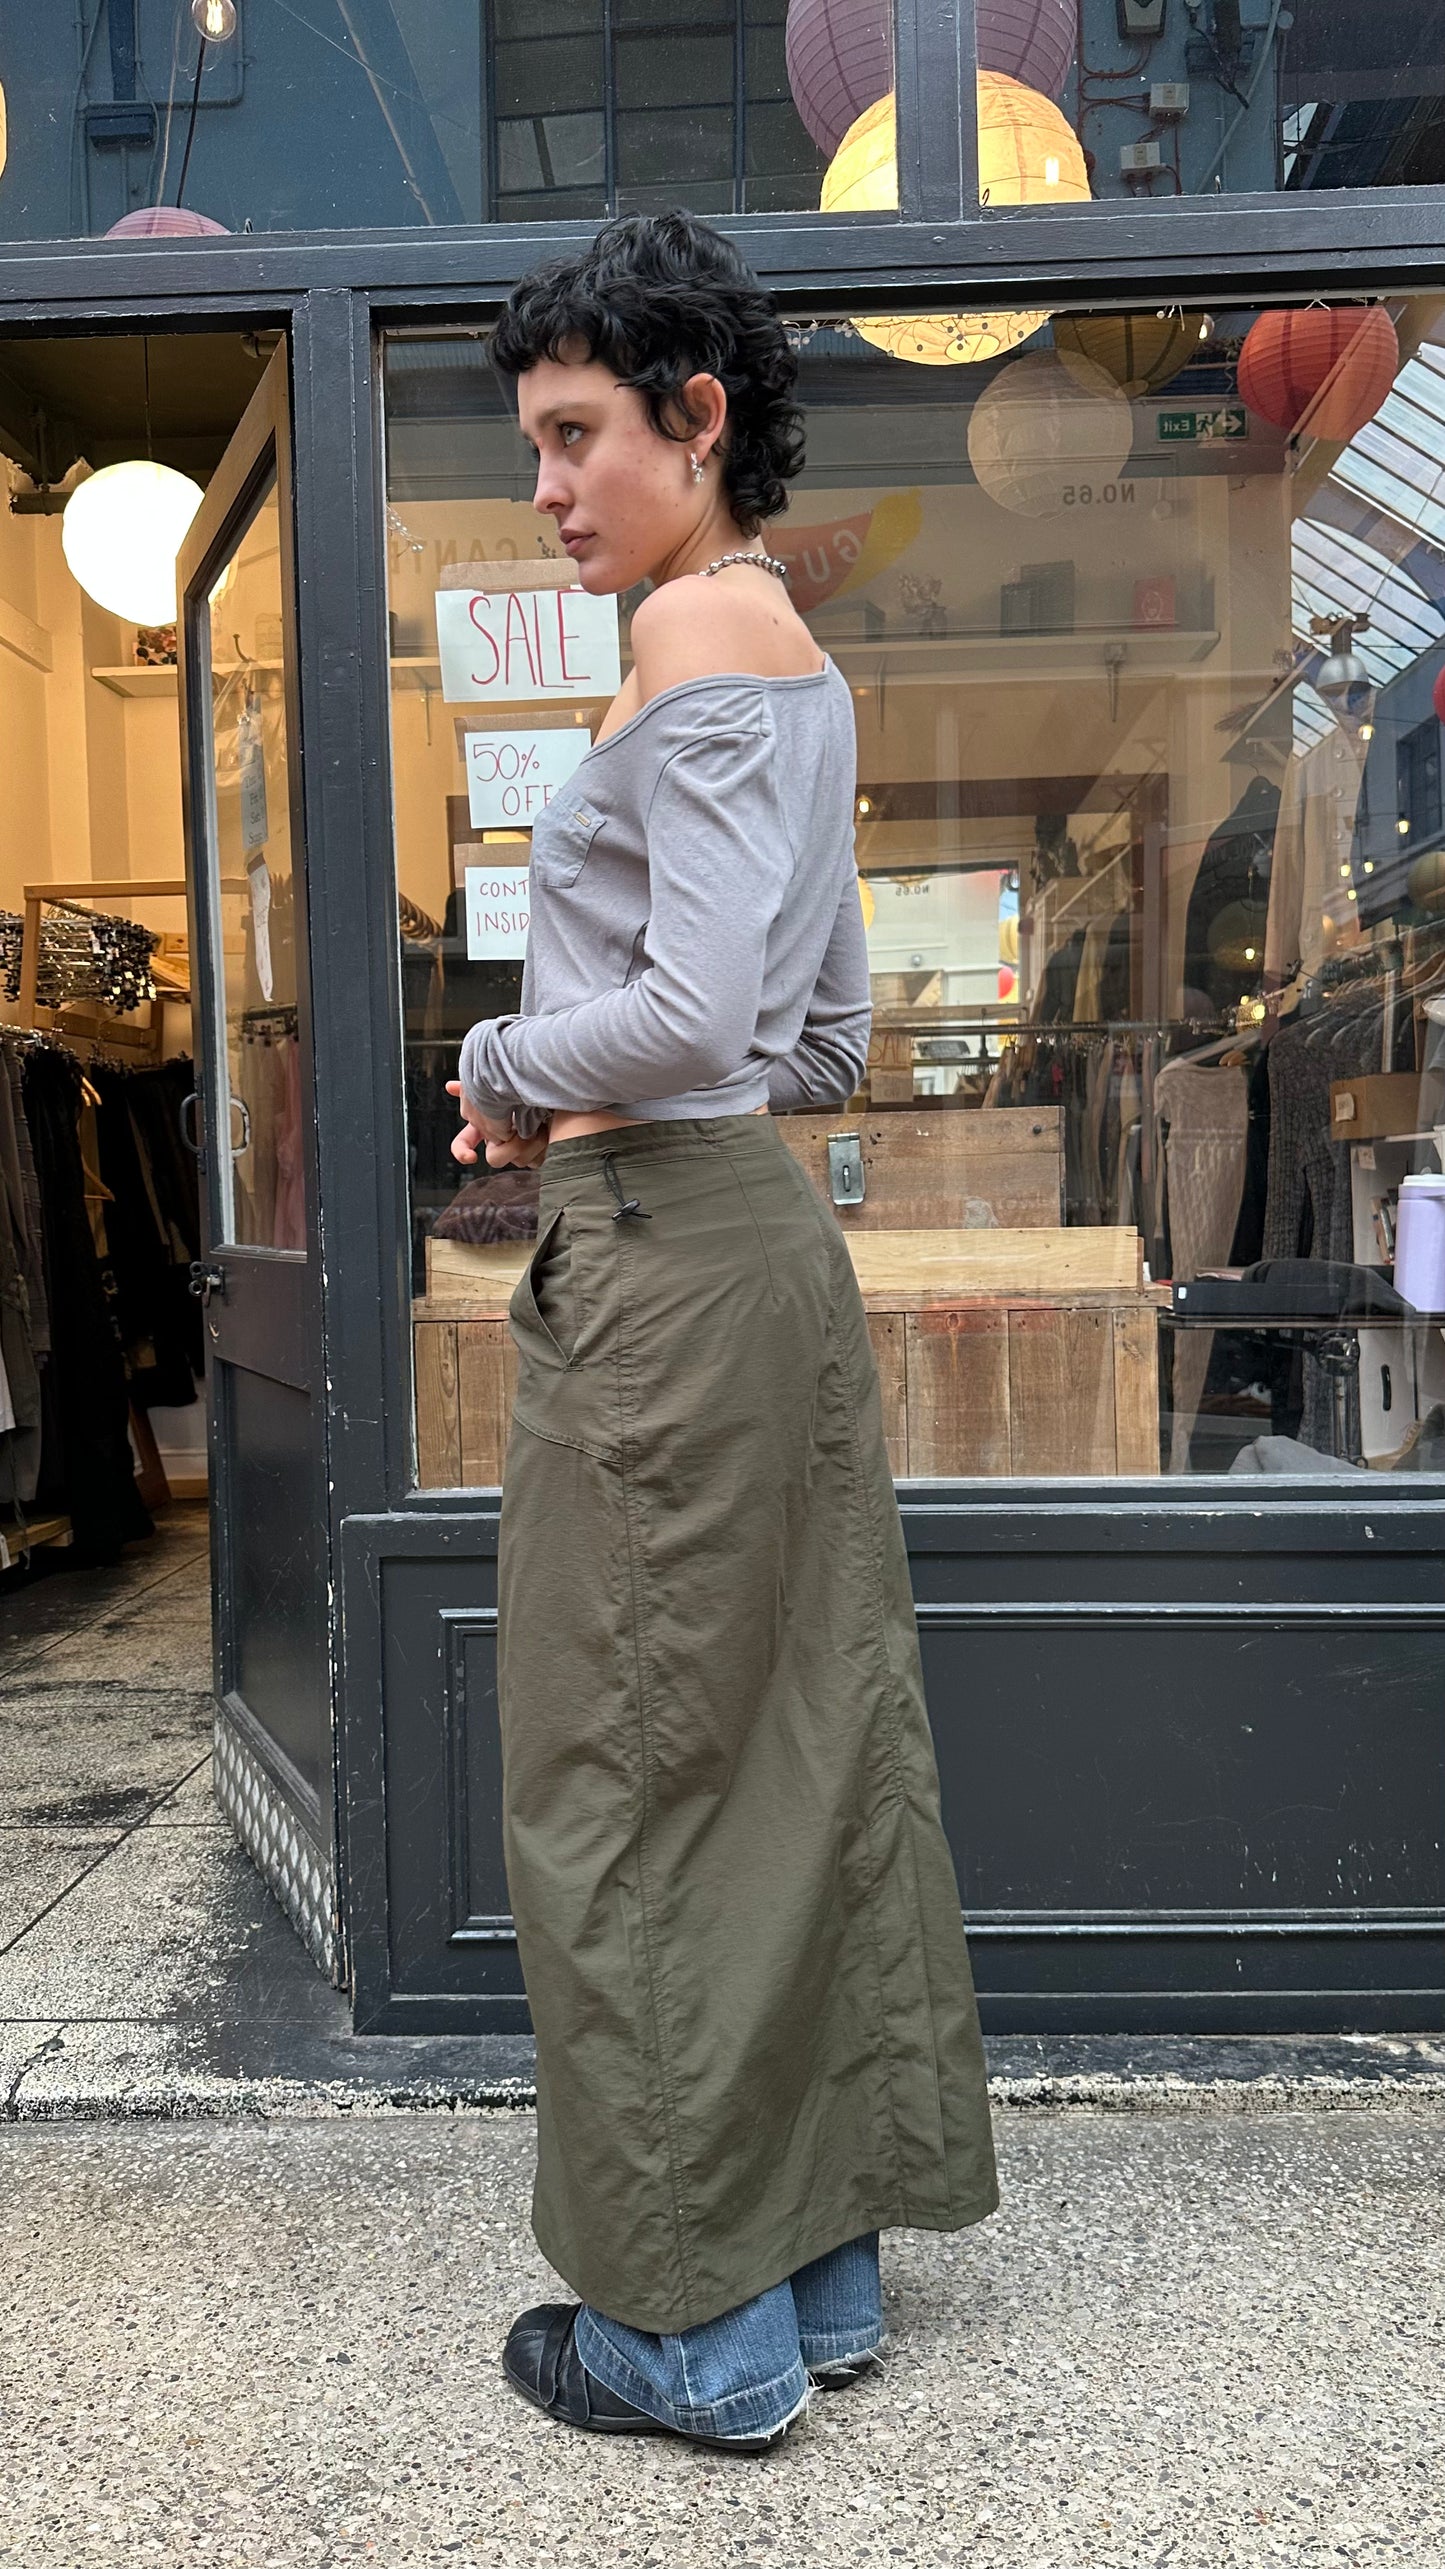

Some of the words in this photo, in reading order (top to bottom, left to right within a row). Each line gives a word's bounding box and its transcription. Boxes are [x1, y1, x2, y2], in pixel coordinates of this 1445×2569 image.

[468, 589, 592, 689] SALE
[473, 742, 540, 782] 50%
[501, 784, 554, 817] OFF
[479, 878, 529, 898] CONT
[476, 911, 530, 937] INSID
